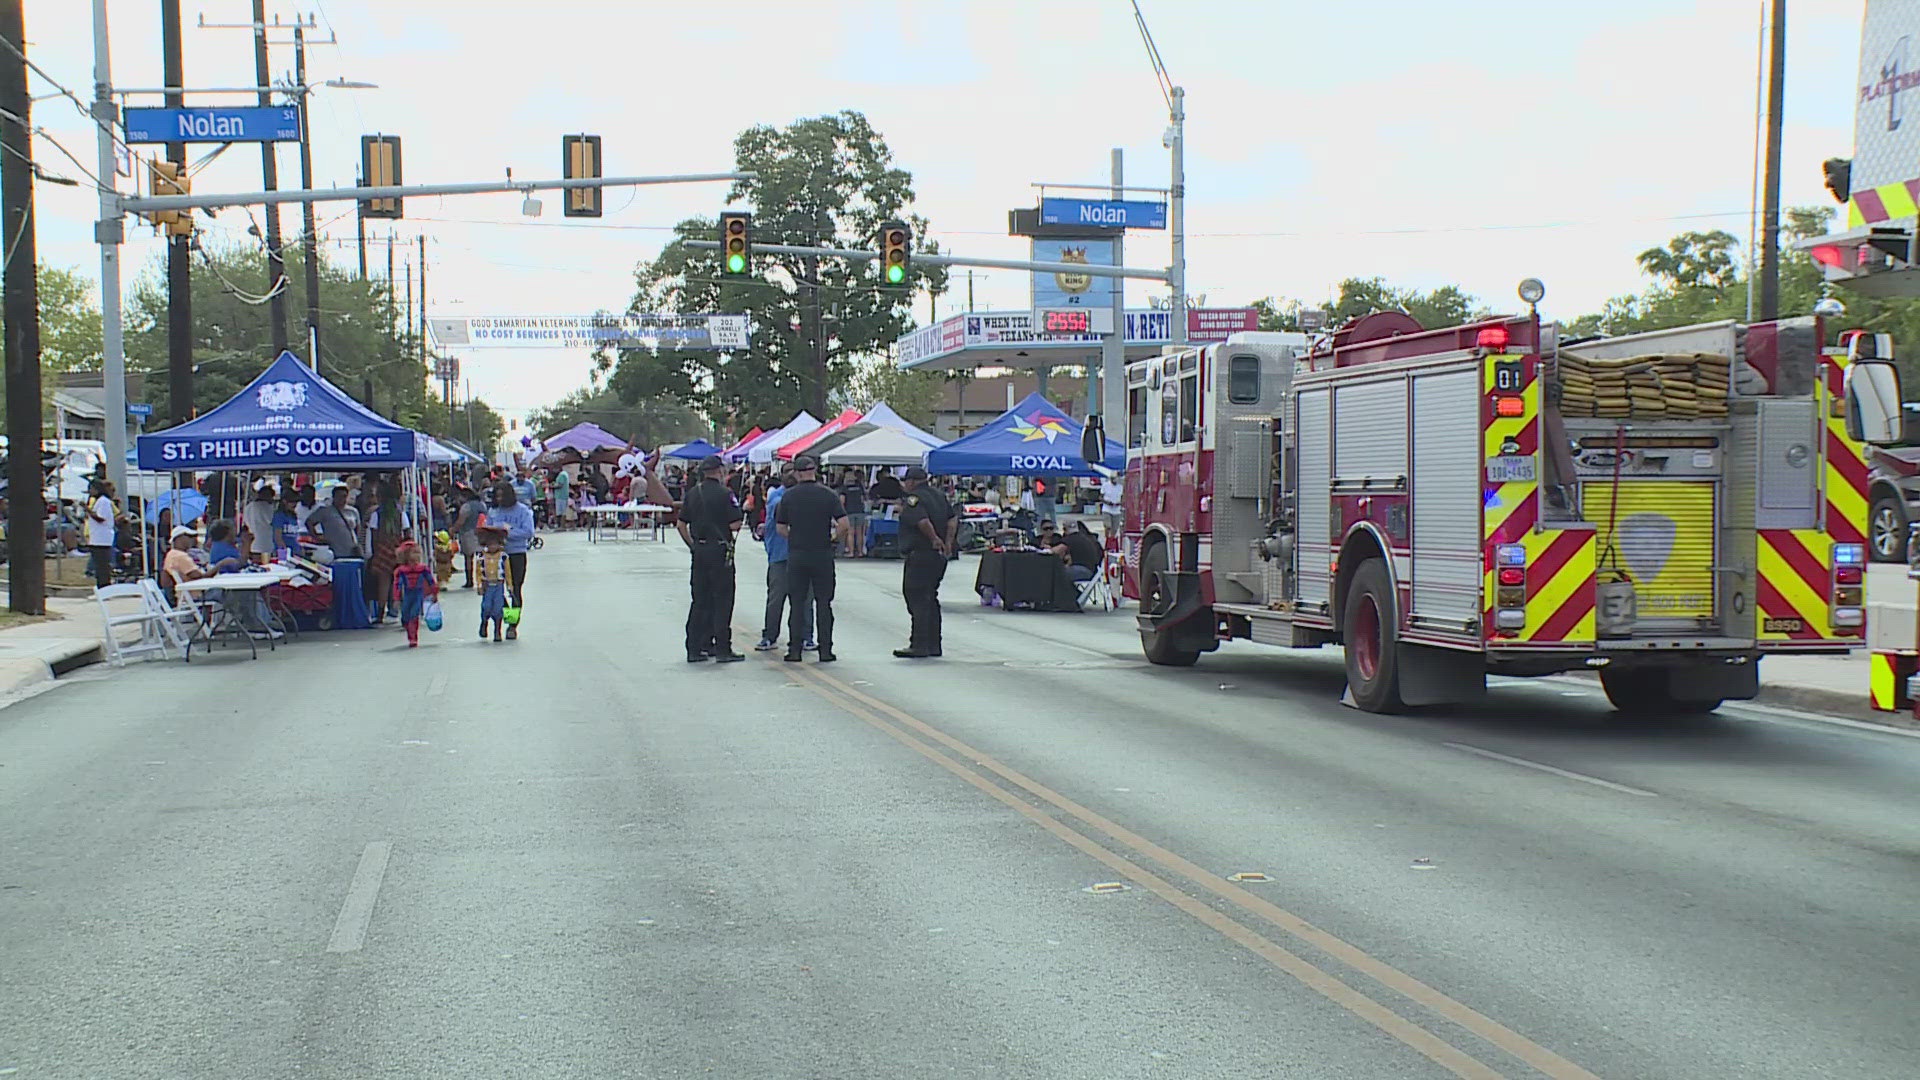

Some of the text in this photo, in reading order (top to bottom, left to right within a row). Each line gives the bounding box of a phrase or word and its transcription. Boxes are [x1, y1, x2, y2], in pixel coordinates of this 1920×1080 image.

[178, 109, 294, 137] Nolan St
[277, 129, 296, 138] 1600
[1080, 204, 1163, 223] Nolan St
[1068, 296, 1080, 304] #2
[471, 319, 491, 328] GOOD
[494, 319, 537, 328] SAMARITAN
[540, 319, 578, 328] VETERANS
[581, 318, 619, 328] OUTREACH
[983, 317, 1009, 329] WHEN
[475, 330, 488, 338] NO
[491, 330, 514, 338] COST
[517, 330, 559, 339] SERVICES
[562, 330, 573, 339] TO
[999, 330, 1034, 342] TEXANS
[1498, 369, 1519, 389] 01
[162, 437, 390, 460] ST. PHILIP'S COLLEGE
[1011, 455, 1072, 470] ROYAL
